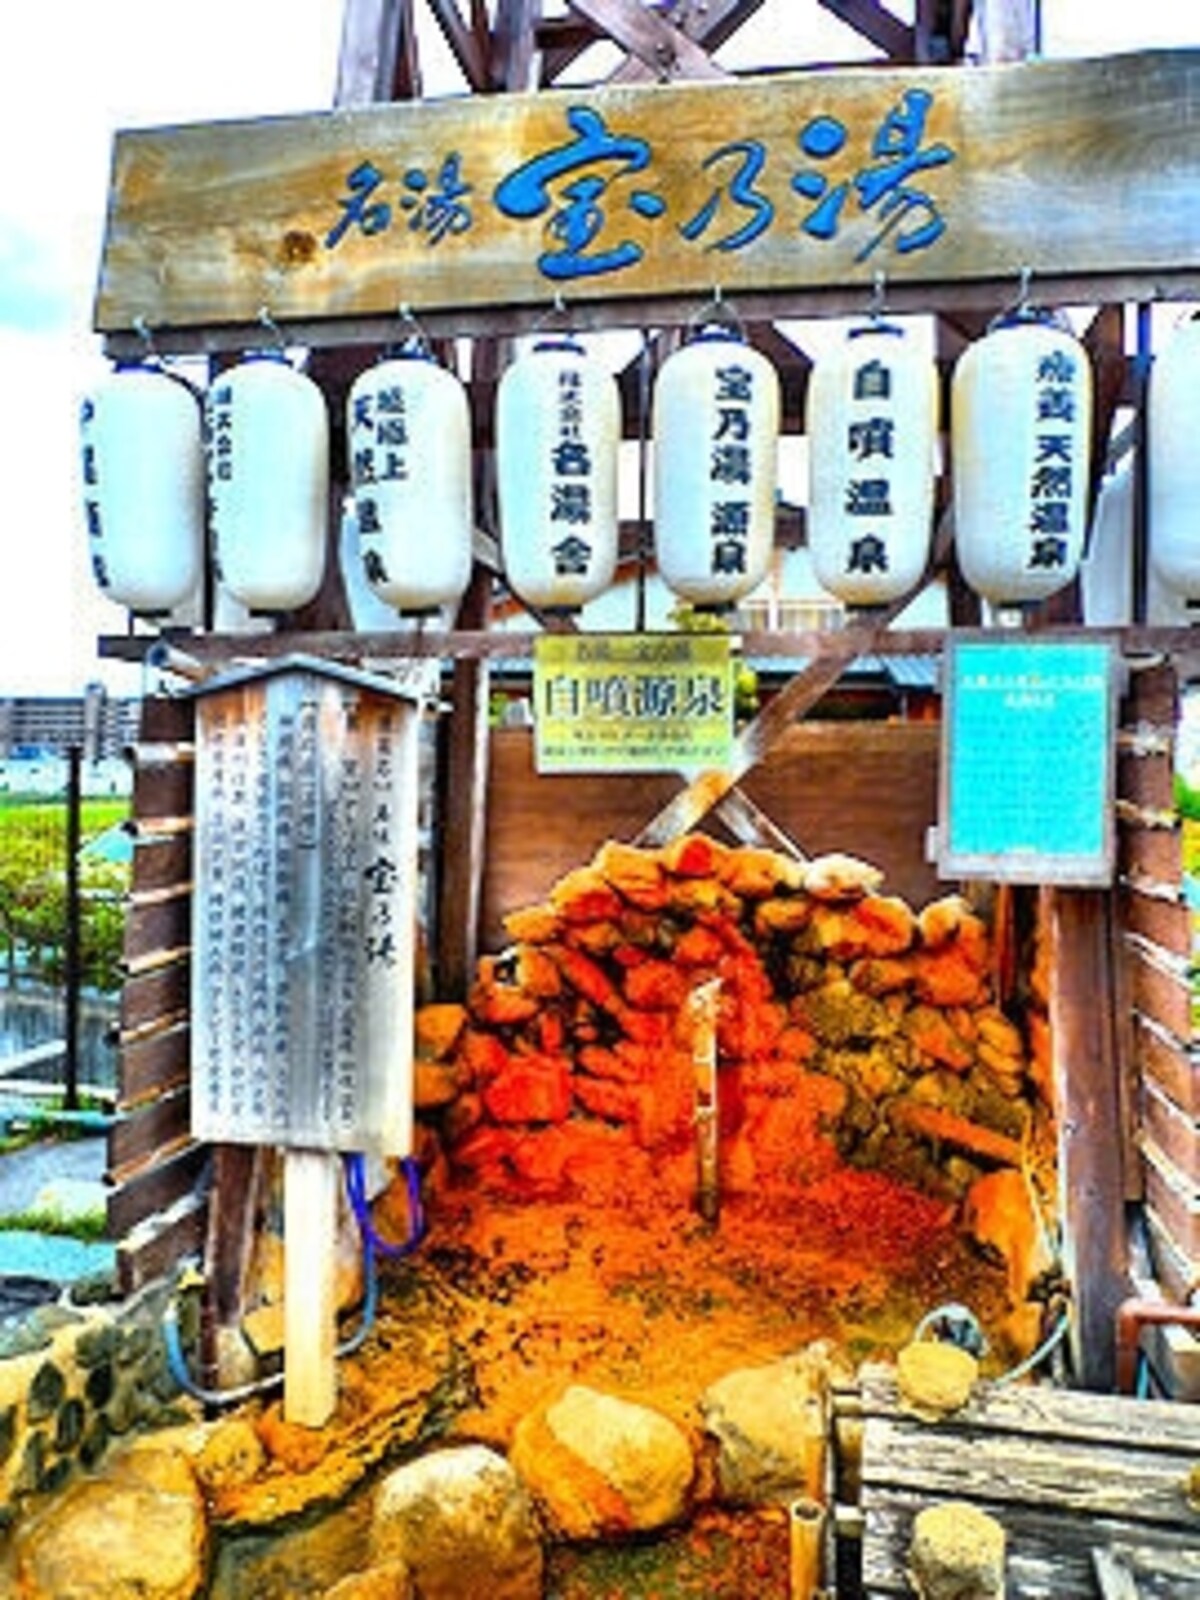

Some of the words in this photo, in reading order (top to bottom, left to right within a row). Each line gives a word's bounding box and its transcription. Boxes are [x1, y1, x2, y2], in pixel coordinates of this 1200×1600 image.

[324, 150, 473, 249] 名湯
[492, 88, 956, 280] 宝乃湯
[844, 358, 896, 574] 自噴温泉
[544, 674, 724, 718] 自噴源泉
